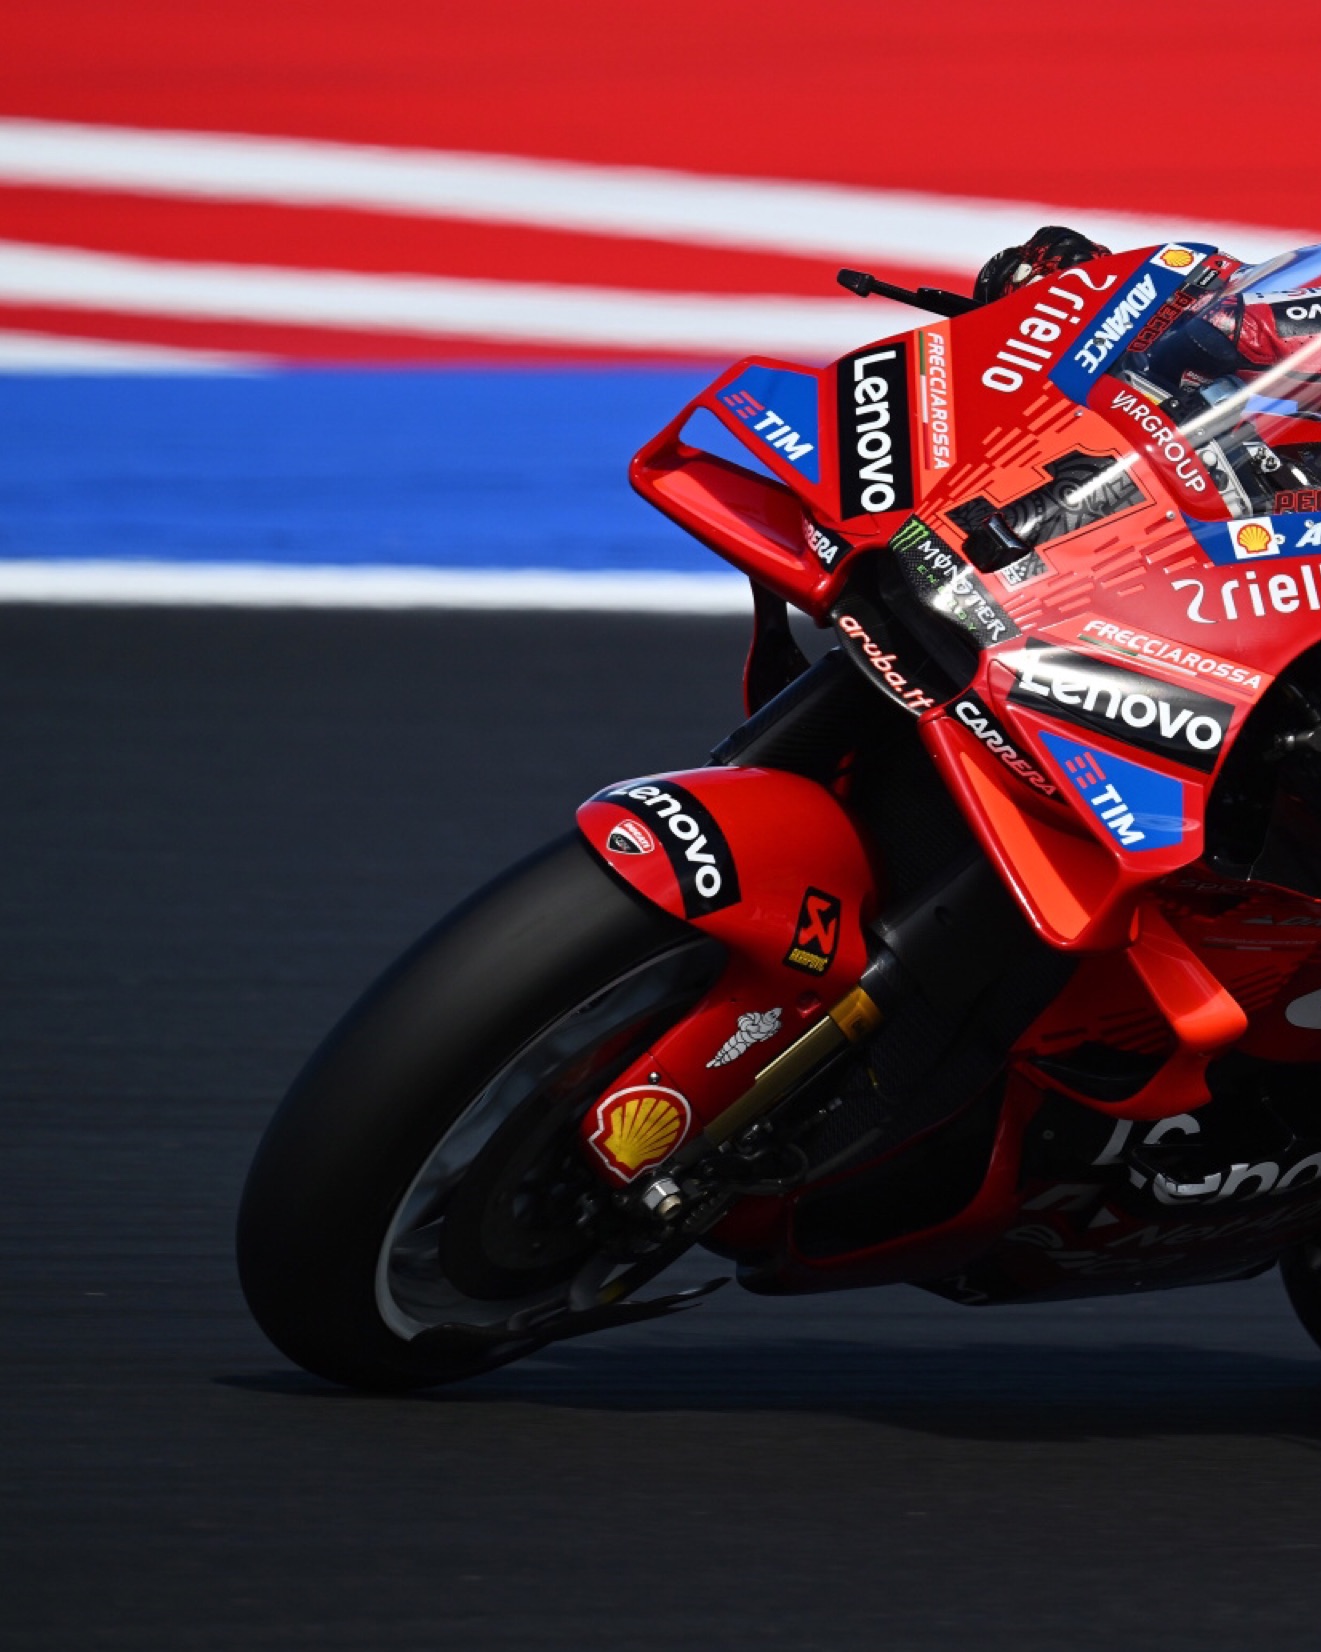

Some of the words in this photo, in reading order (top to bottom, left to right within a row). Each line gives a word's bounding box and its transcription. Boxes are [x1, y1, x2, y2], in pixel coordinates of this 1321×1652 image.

[1074, 272, 1159, 375] ADVANCE
[1127, 290, 1195, 353] PECCO
[753, 408, 815, 463] TIM
[853, 350, 897, 513] Lenovo
[926, 331, 952, 470] FRECCIAROSSA
[918, 541, 1006, 642] MONSTER
[839, 614, 937, 712] aruba.it
[1018, 652, 1222, 750] Lenovo
[1083, 619, 1262, 689] FRECCIAROSSA
[954, 700, 1058, 797] CARRERA
[608, 786, 722, 898] Lenovo
[1091, 783, 1145, 847] TIM
